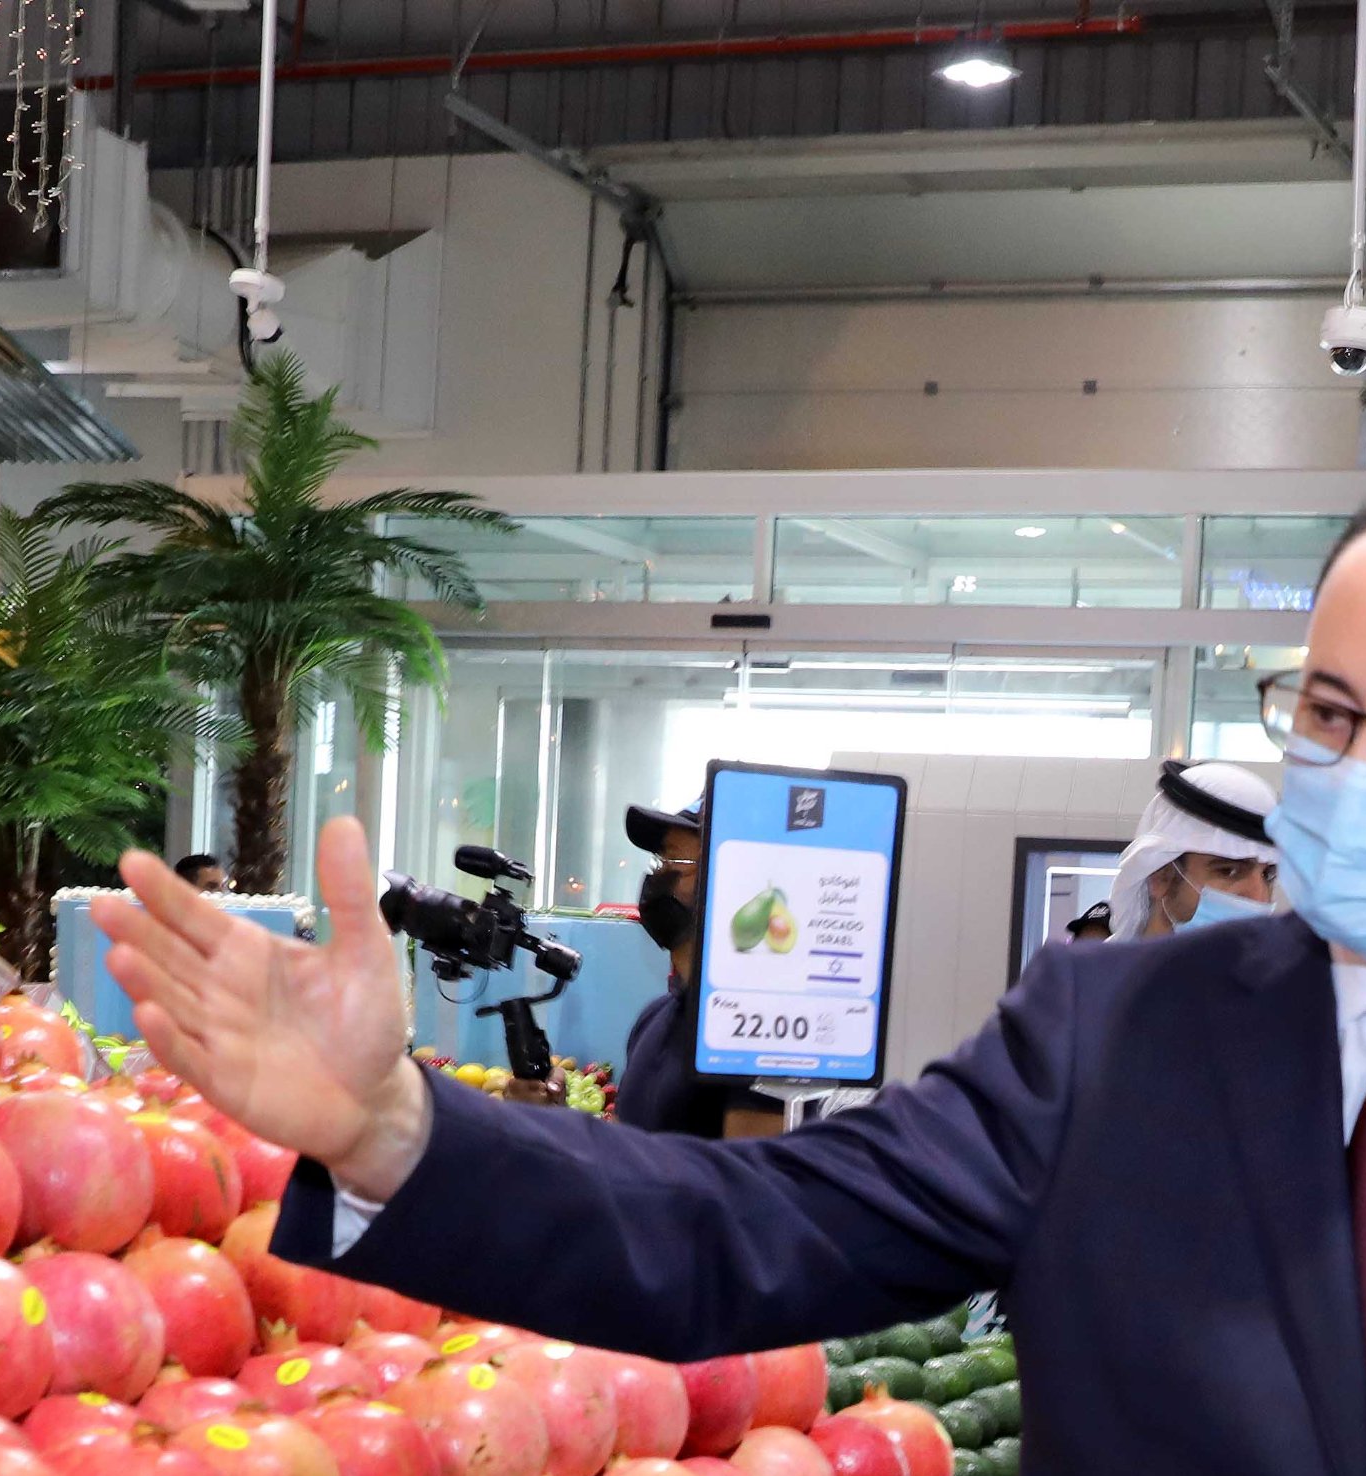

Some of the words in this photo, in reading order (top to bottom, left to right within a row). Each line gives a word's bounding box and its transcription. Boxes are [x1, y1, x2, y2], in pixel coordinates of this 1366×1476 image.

[807, 919, 865, 932] AVOCADO
[816, 933, 854, 946] ISRAEL
[713, 996, 739, 1009] Price
[731, 1013, 809, 1040] 22.00
